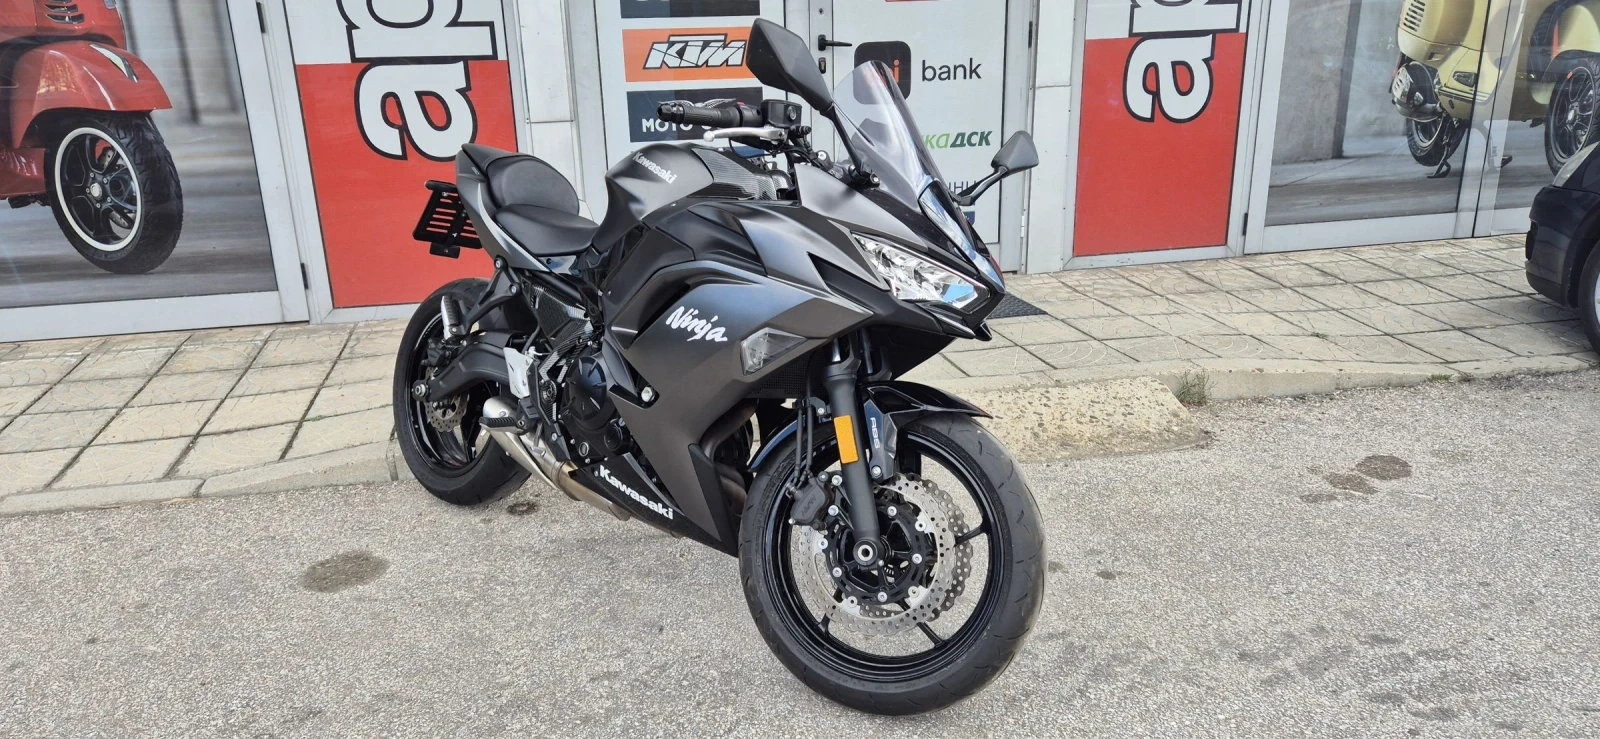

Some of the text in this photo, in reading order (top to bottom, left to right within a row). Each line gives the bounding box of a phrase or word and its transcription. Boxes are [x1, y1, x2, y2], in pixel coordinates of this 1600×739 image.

[643, 33, 748, 70] KTM
[921, 57, 982, 82] bank
[632, 151, 678, 184] Kawasaki
[665, 306, 728, 342] Ninja
[869, 417, 881, 449] ABS
[599, 464, 674, 520] Kawasaki
